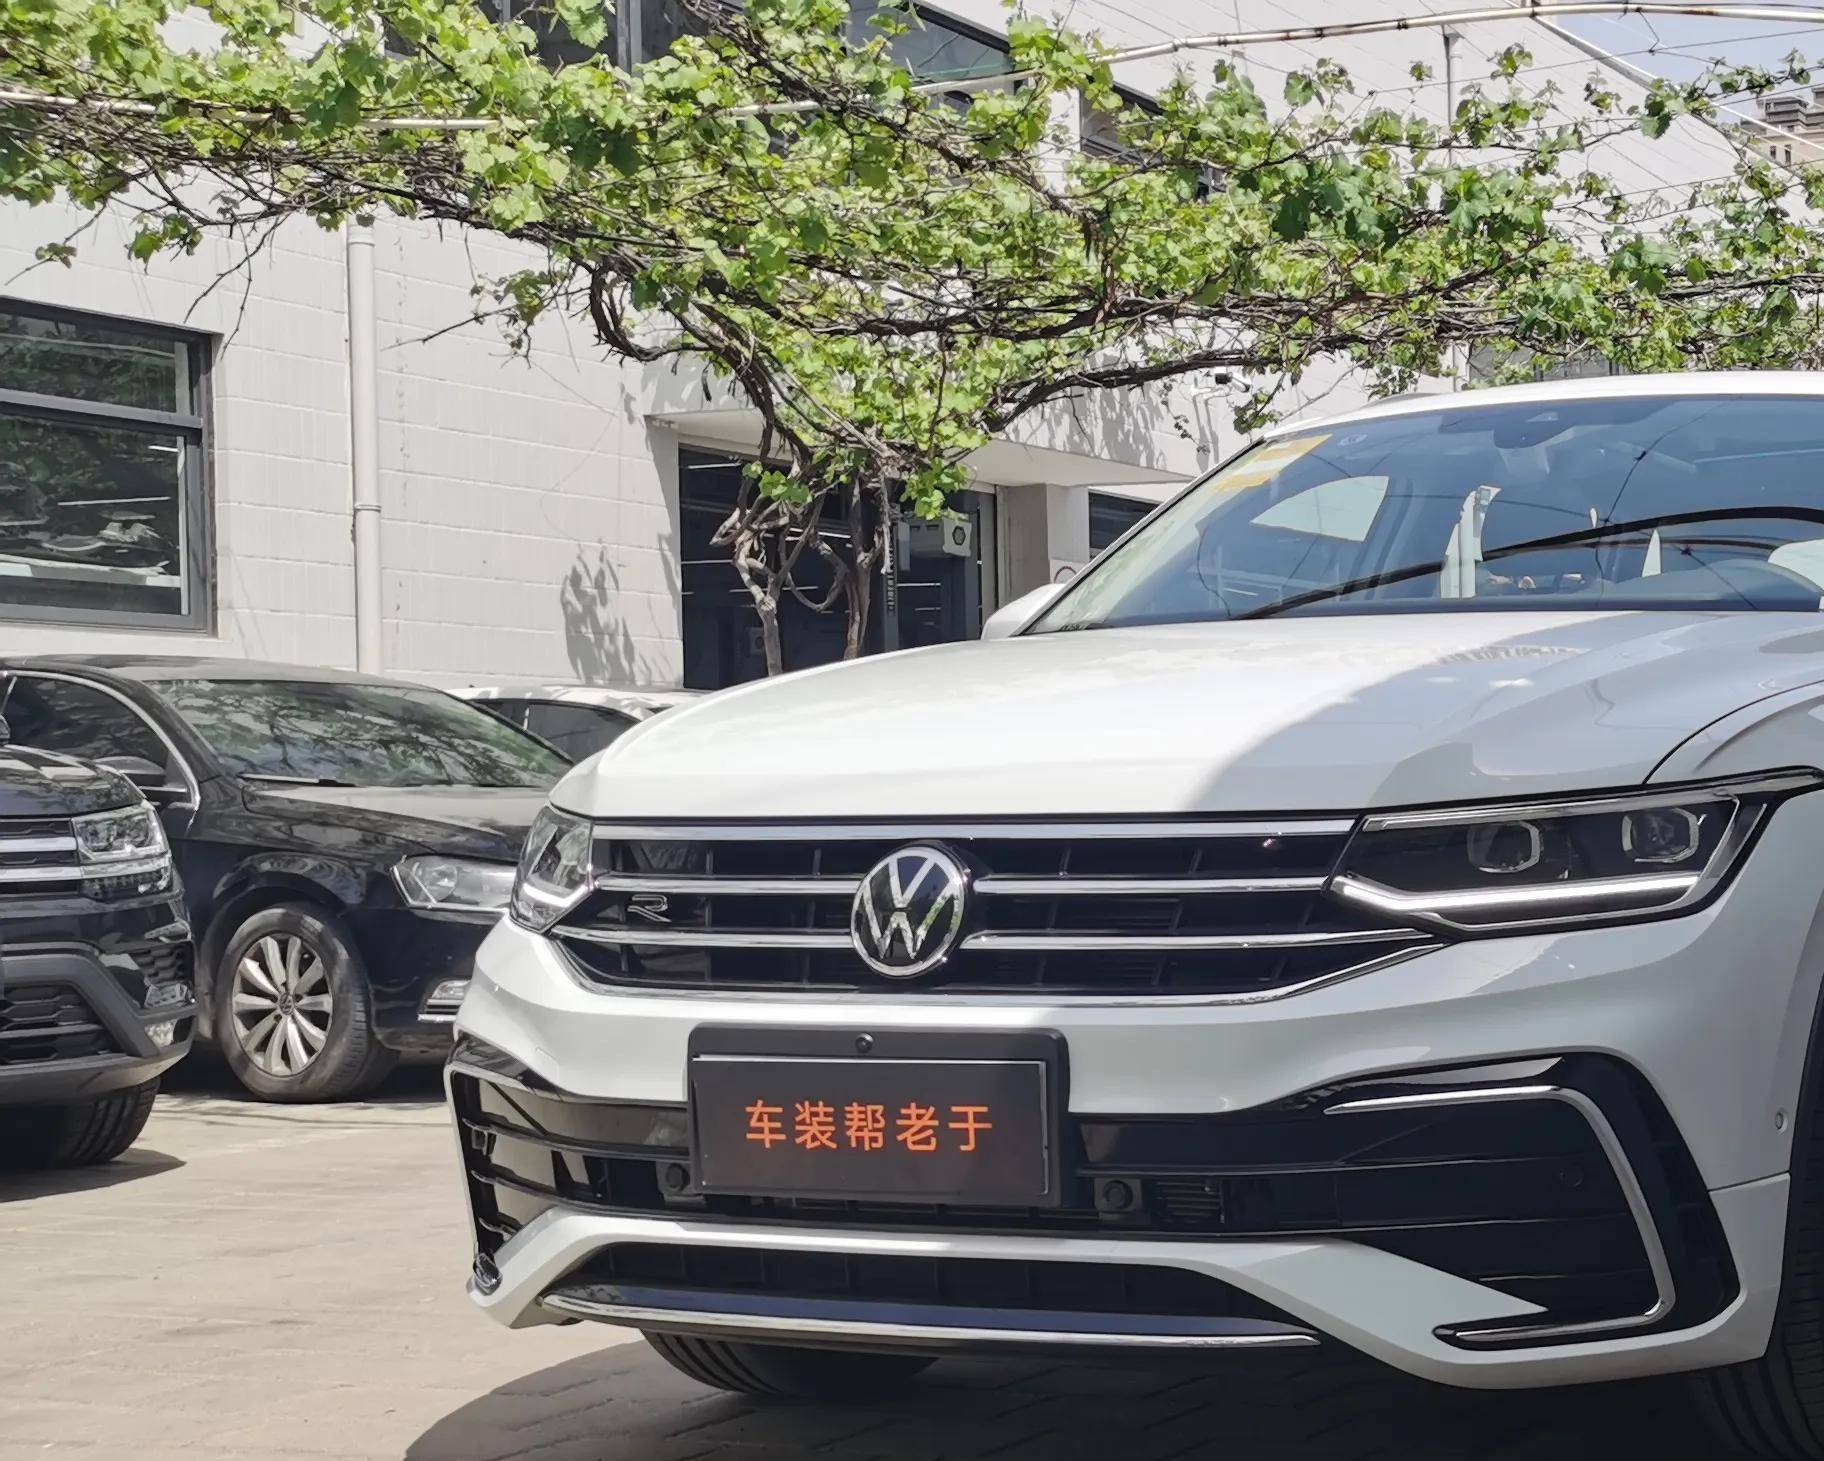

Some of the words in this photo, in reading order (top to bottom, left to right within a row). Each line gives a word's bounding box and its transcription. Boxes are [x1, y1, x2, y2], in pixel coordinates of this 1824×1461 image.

[853, 847, 963, 972] VW
[745, 1099, 993, 1151] 车装帮老于
